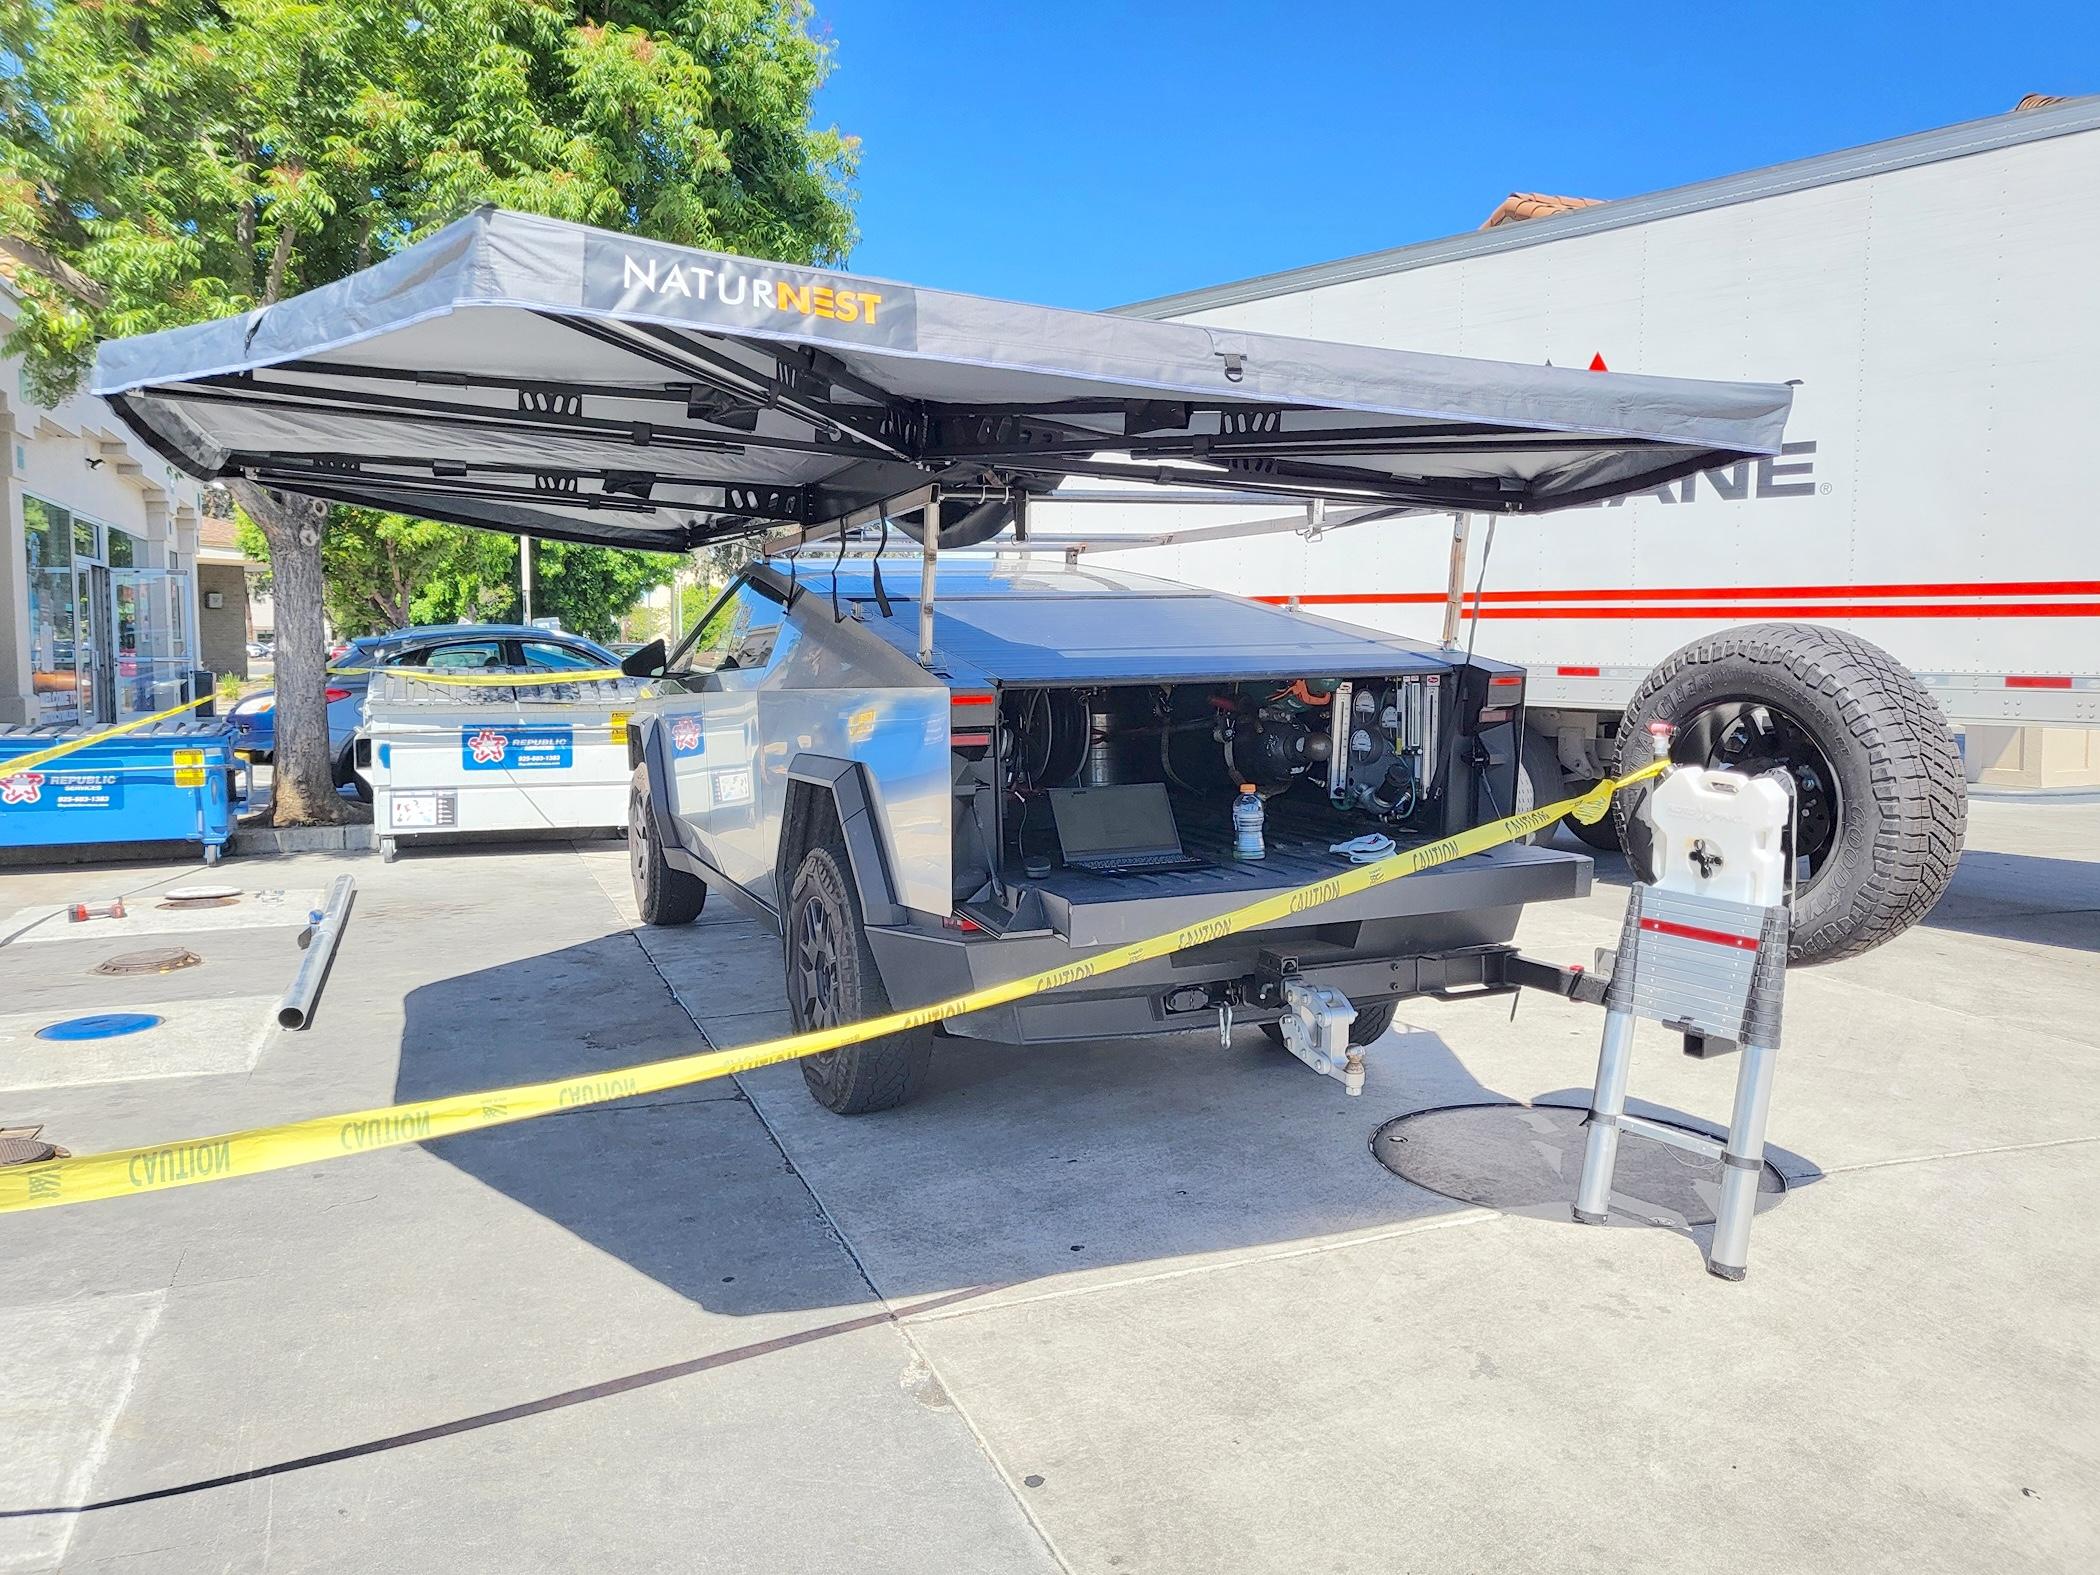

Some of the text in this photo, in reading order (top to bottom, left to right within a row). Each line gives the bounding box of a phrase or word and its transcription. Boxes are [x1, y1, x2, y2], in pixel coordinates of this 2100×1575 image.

[623, 254, 882, 325] NATURNEST
[512, 738, 567, 746] REPUBLIC
[50, 776, 117, 785] REPUBLIC
[1504, 810, 1551, 836] CAUTION
[1412, 840, 1460, 872] CAUTION
[1289, 880, 1341, 913] CAUTION
[1177, 917, 1232, 950] CAUTION
[1036, 962, 1095, 992] CAUTION
[904, 1001, 967, 1029] CAUTION
